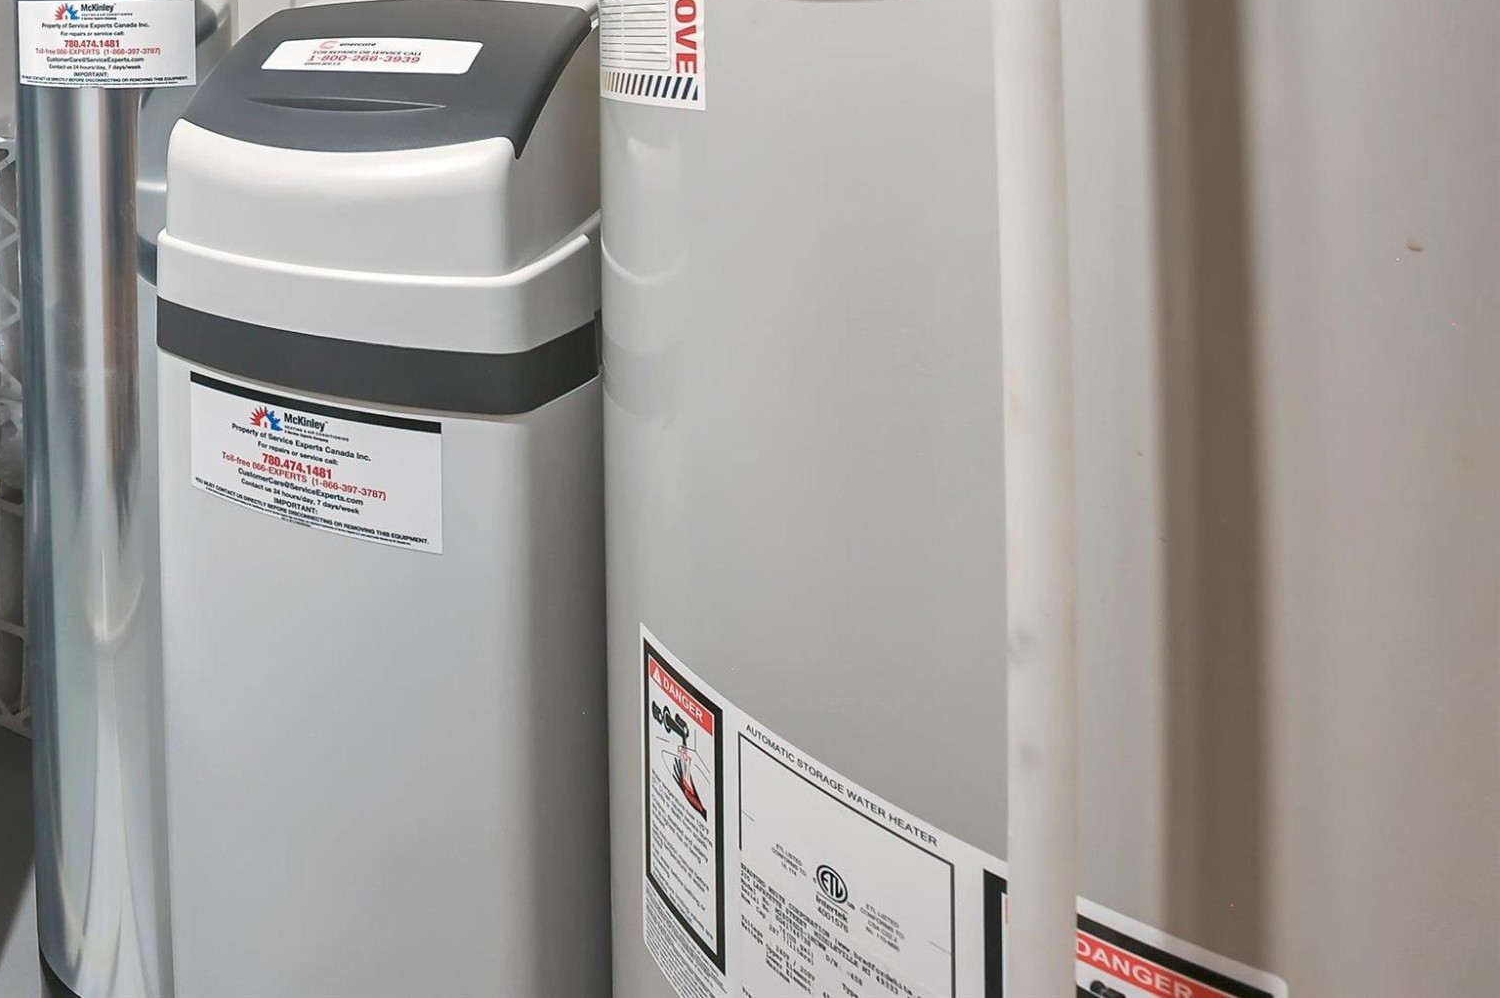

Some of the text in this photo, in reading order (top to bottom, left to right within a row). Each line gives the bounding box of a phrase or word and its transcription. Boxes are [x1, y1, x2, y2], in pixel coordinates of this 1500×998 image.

[81, 4, 114, 12] McKinley
[308, 55, 420, 63] 1-800-266-3939
[284, 413, 326, 432] McKinley
[232, 423, 258, 438] Property
[260, 430, 266, 439] of
[268, 433, 293, 445] Service
[296, 440, 323, 453] Experts
[325, 446, 354, 459] Canada
[356, 452, 372, 462] Inc.
[262, 453, 332, 479] 780.474.1481
[238, 467, 364, 506] CustomerCare@ServiceExperts.com
[274, 497, 318, 515] IMPORTANT:
[661, 675, 705, 725] DANGER
[746, 724, 938, 847] AUTOMATIC STORAGE WATER HEATER
[821, 870, 843, 898] ETL
[816, 894, 848, 923] Intertek
[1076, 937, 1192, 998] DANGER
